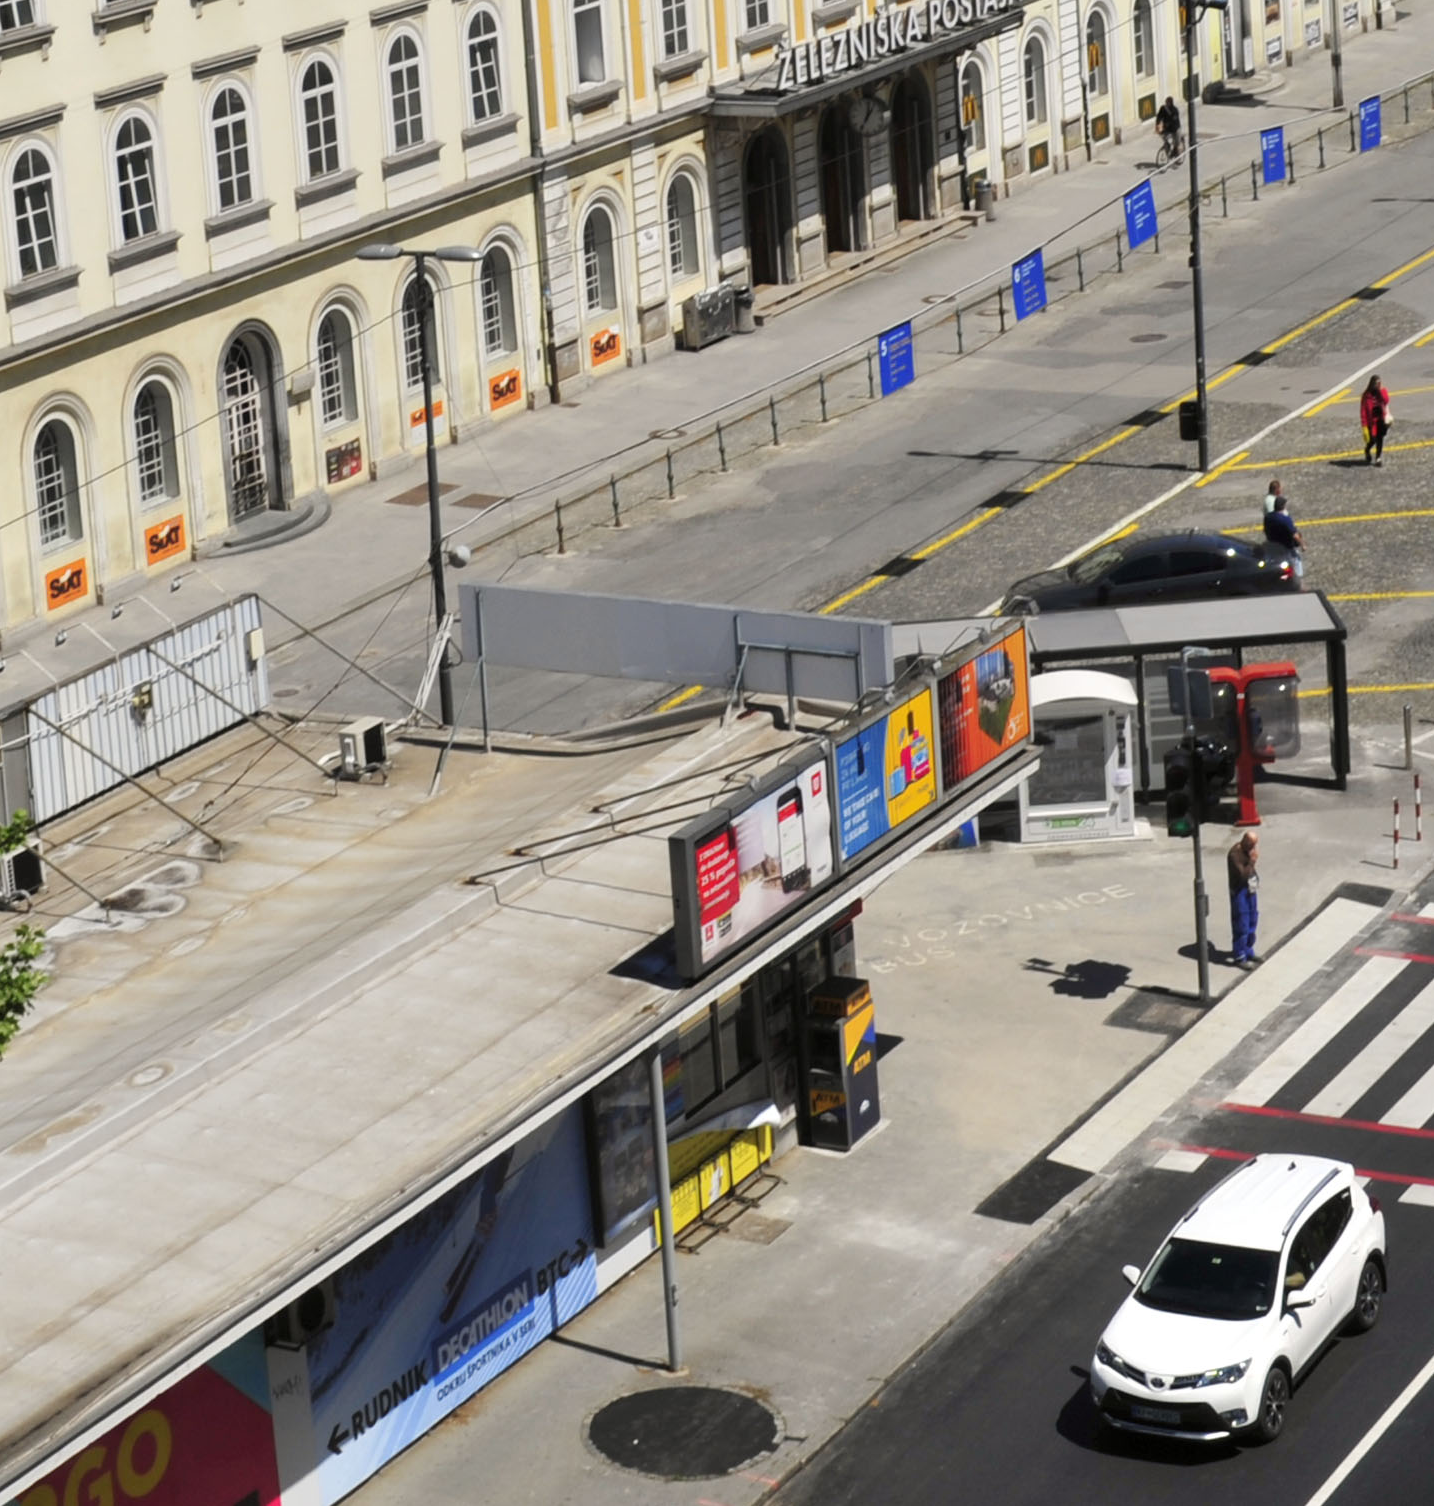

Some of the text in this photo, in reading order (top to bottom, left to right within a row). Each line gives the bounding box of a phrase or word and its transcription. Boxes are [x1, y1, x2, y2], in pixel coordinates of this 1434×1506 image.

[778, 5, 922, 90] ŽELEZNIŠKA
[880, 340, 887, 357] 5
[885, 884, 1135, 948] VOZOVNICE
[872, 946, 956, 974] BUS
[351, 1250, 570, 1440] RUDNIK DECATHLON BTC
[19, 1409, 172, 1506] GO
